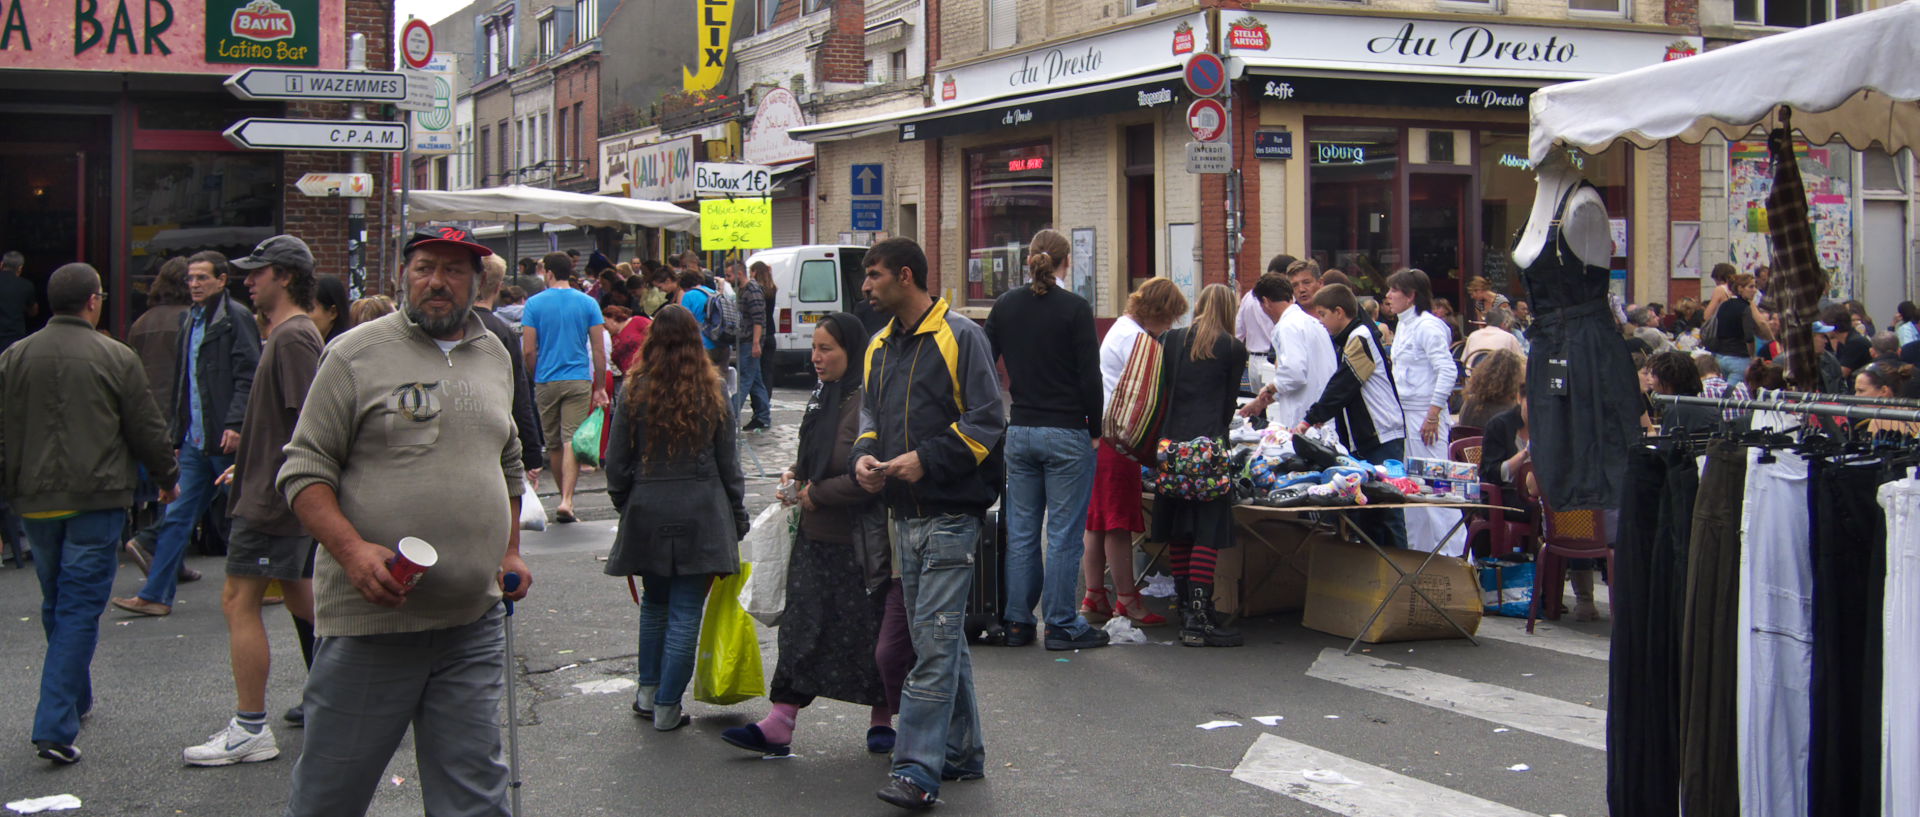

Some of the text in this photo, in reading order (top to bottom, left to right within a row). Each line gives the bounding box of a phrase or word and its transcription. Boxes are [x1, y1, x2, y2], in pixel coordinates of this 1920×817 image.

[0, 0, 173, 56] A BAR
[238, 15, 289, 31] BAVIK
[704, 0, 727, 67] LIX
[1233, 30, 1263, 38] STELLA
[1233, 38, 1264, 46] ARTOIS
[1366, 22, 1579, 64] Au Presto
[219, 39, 308, 60] Latino Bar
[1009, 47, 1104, 87] Au Presto
[310, 78, 398, 93] WAZEMMES
[1263, 81, 1295, 100] Leffe
[1455, 89, 1524, 108] Au Presto
[329, 129, 399, 144] C.P.A.M.
[1318, 143, 1364, 165] Loburg
[742, 169, 768, 191] 1€
